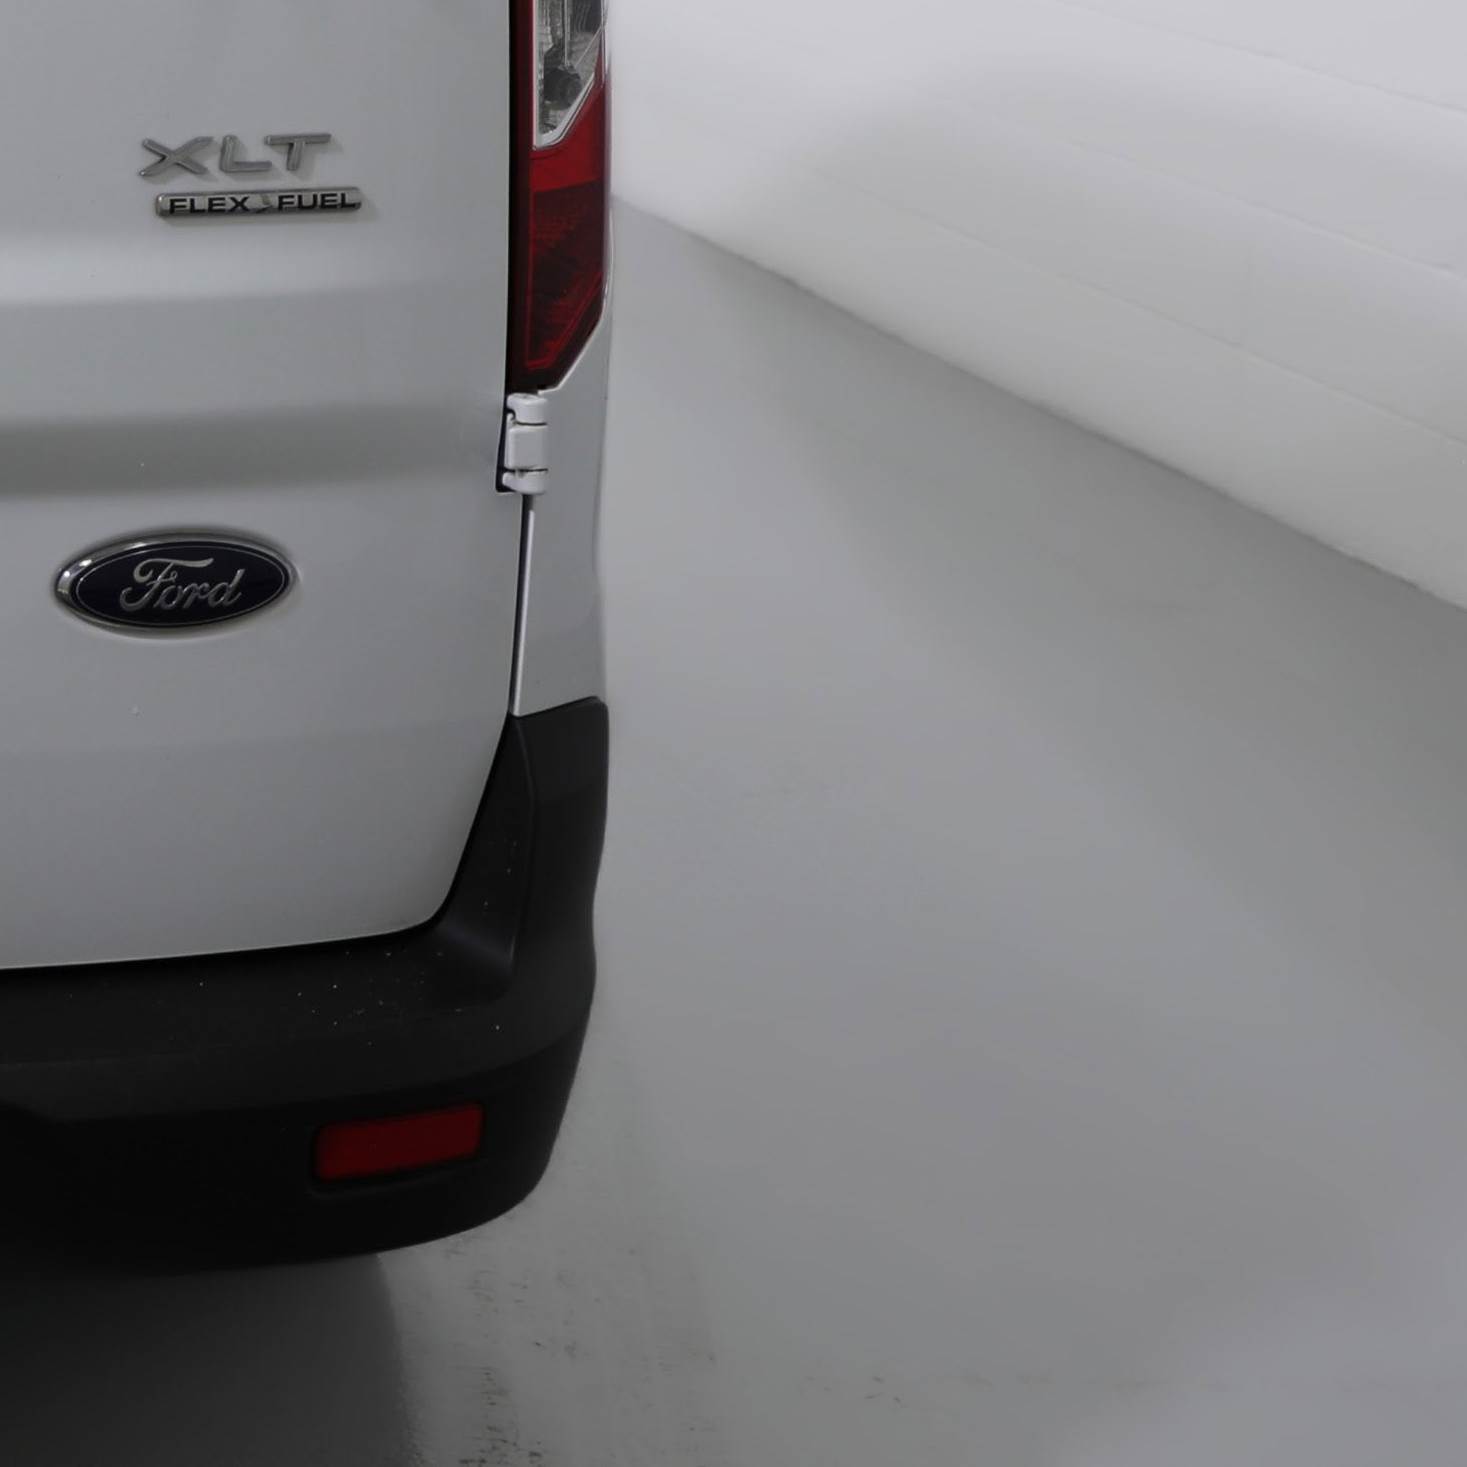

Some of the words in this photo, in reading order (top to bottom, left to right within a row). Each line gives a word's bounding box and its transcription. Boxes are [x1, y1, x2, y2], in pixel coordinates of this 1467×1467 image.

[138, 133, 332, 177] XLT
[168, 196, 251, 214] FLEX
[277, 192, 358, 211] FUEL
[119, 557, 246, 612] Ford
